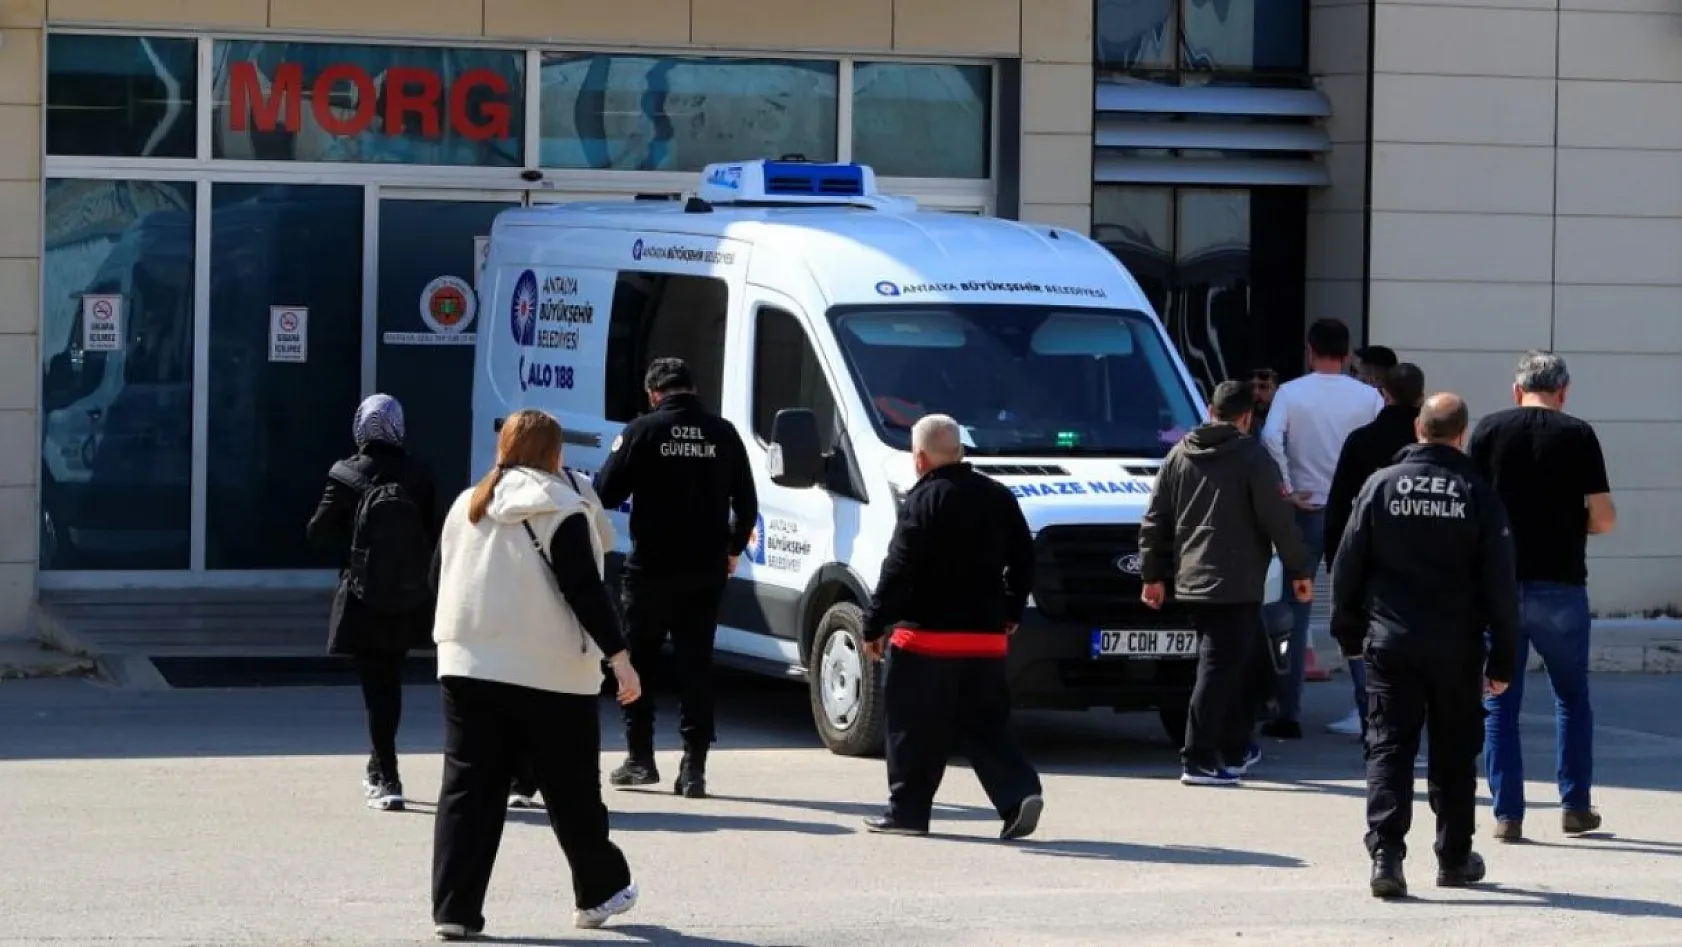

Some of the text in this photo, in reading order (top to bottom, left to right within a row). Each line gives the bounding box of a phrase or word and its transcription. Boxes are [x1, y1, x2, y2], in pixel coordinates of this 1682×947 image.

[228, 60, 511, 141] MORG
[542, 277, 578, 295] ANTALYA
[903, 280, 1107, 298] ANTALYA BÜYÜKŞEHİR BELEDİYESİ
[539, 298, 593, 327] BÜYÜKŞEHİR
[537, 327, 579, 351] BELEDİYESİ
[527, 363, 574, 389] ALO 188
[671, 424, 705, 440] ÖZEL
[660, 441, 717, 458] GÜVENLİK
[1008, 481, 1087, 498] ENAZE
[1396, 475, 1460, 498] ÖZEL
[1390, 497, 1466, 519] GÜVENLİK
[767, 533, 811, 556] BÜYÜKŞEHİR
[1102, 631, 1121, 652] 07
[1166, 632, 1195, 652] 787
